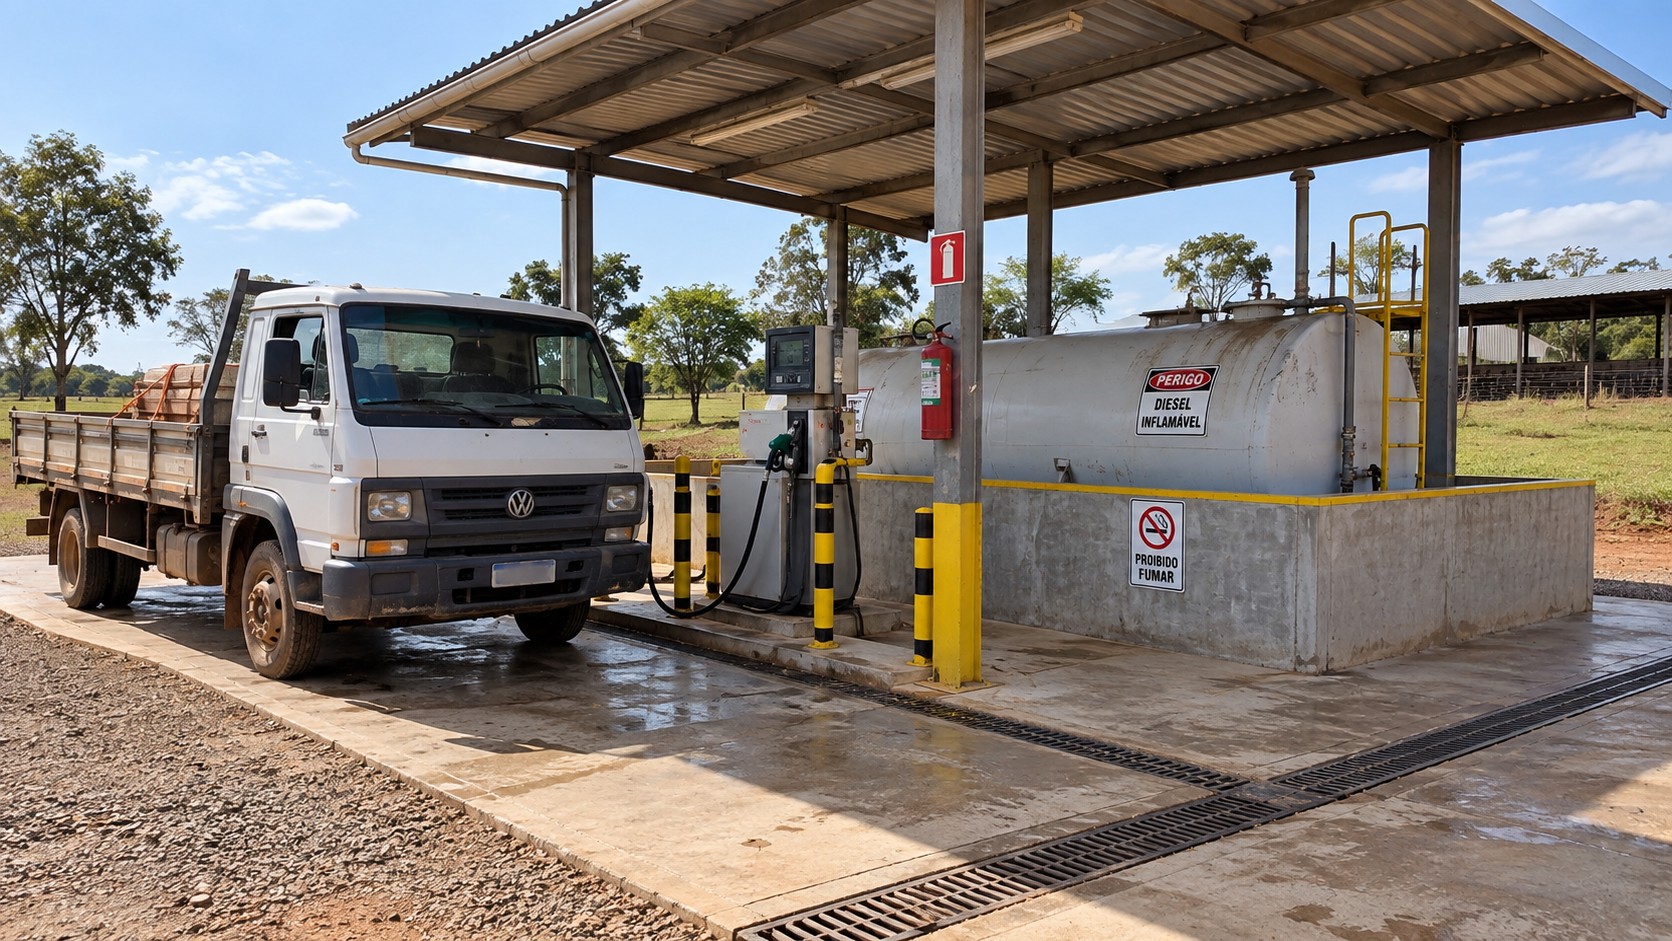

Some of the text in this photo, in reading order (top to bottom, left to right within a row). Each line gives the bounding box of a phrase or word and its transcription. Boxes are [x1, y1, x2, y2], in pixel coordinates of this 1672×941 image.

[1156, 373, 1204, 387] PERIGO
[1154, 397, 1191, 411] DIESEL
[1141, 413, 1201, 428] INFLAMÁVEL
[508, 489, 535, 518] VW
[1135, 553, 1178, 569] PROIBIDO
[1138, 568, 1175, 583] FUMAR
